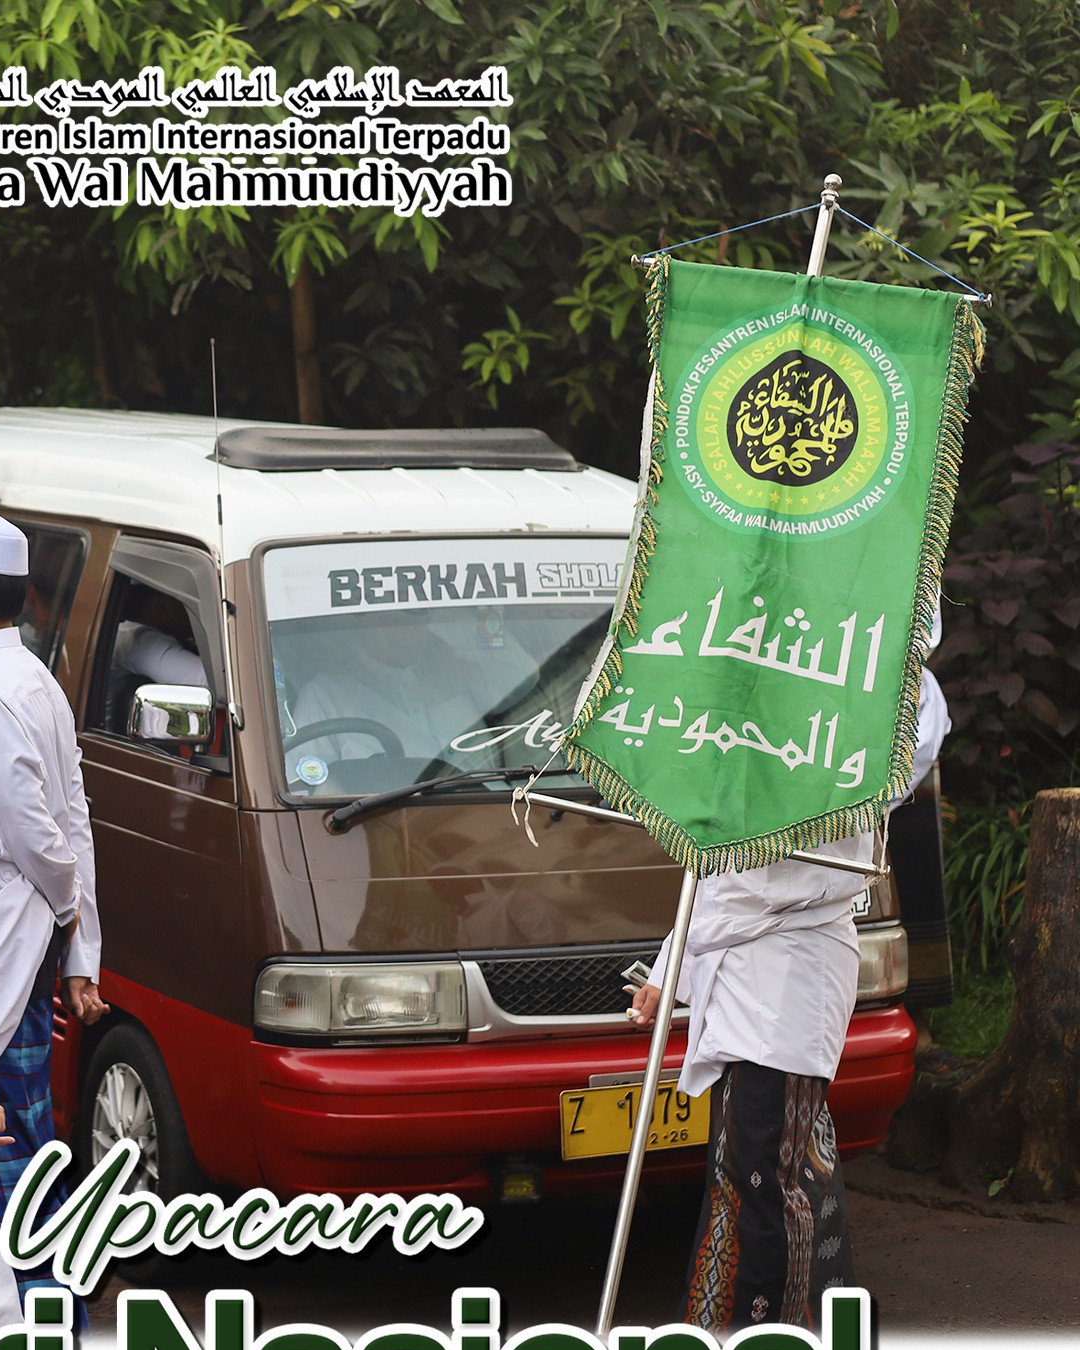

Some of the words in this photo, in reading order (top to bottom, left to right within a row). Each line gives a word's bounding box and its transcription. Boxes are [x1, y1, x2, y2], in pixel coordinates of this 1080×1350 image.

[327, 562, 528, 608] BERKAH
[568, 1095, 586, 1136] Z
[623, 1086, 691, 1130] 179
